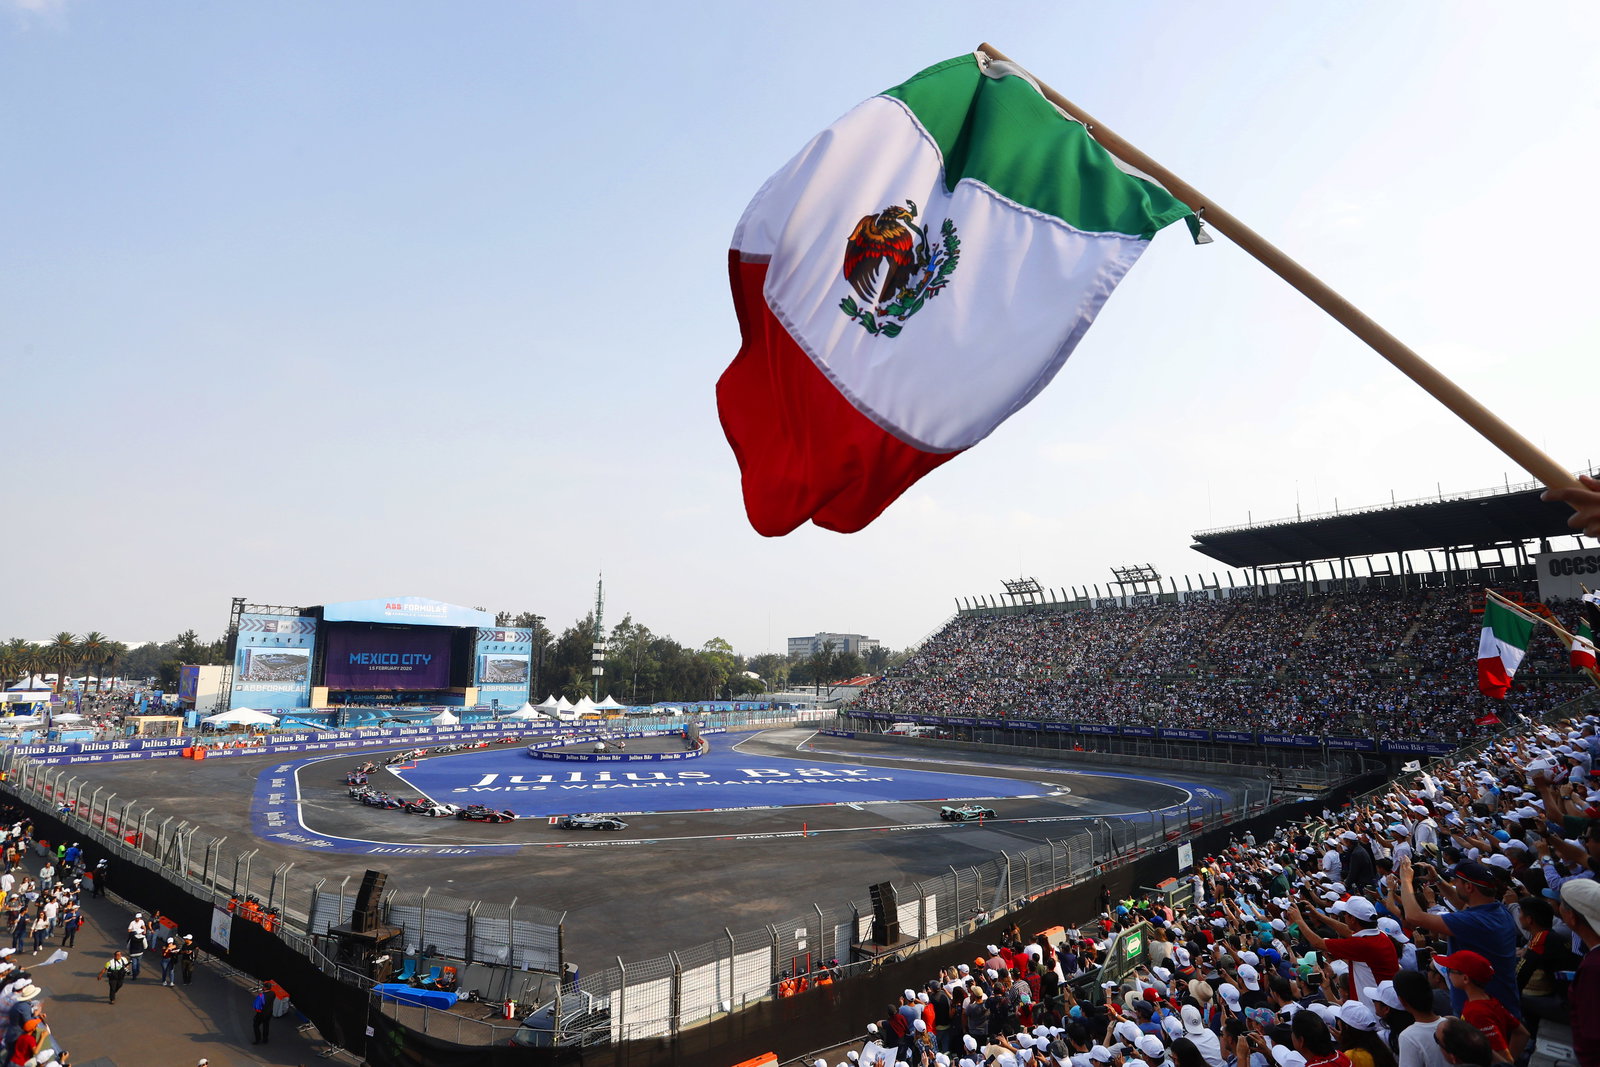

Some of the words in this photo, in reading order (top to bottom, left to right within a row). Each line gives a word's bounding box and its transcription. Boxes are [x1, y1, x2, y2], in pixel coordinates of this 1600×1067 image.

[349, 653, 399, 664] MEXICO
[402, 654, 431, 665] CITY
[48, 745, 68, 753] Bär
[80, 743, 110, 752] Julius
[112, 741, 130, 749] Bär
[142, 740, 167, 749] Julius
[470, 771, 711, 787] Julius
[736, 768, 868, 778] Bär
[697, 777, 894, 785] MANAGEMENT
